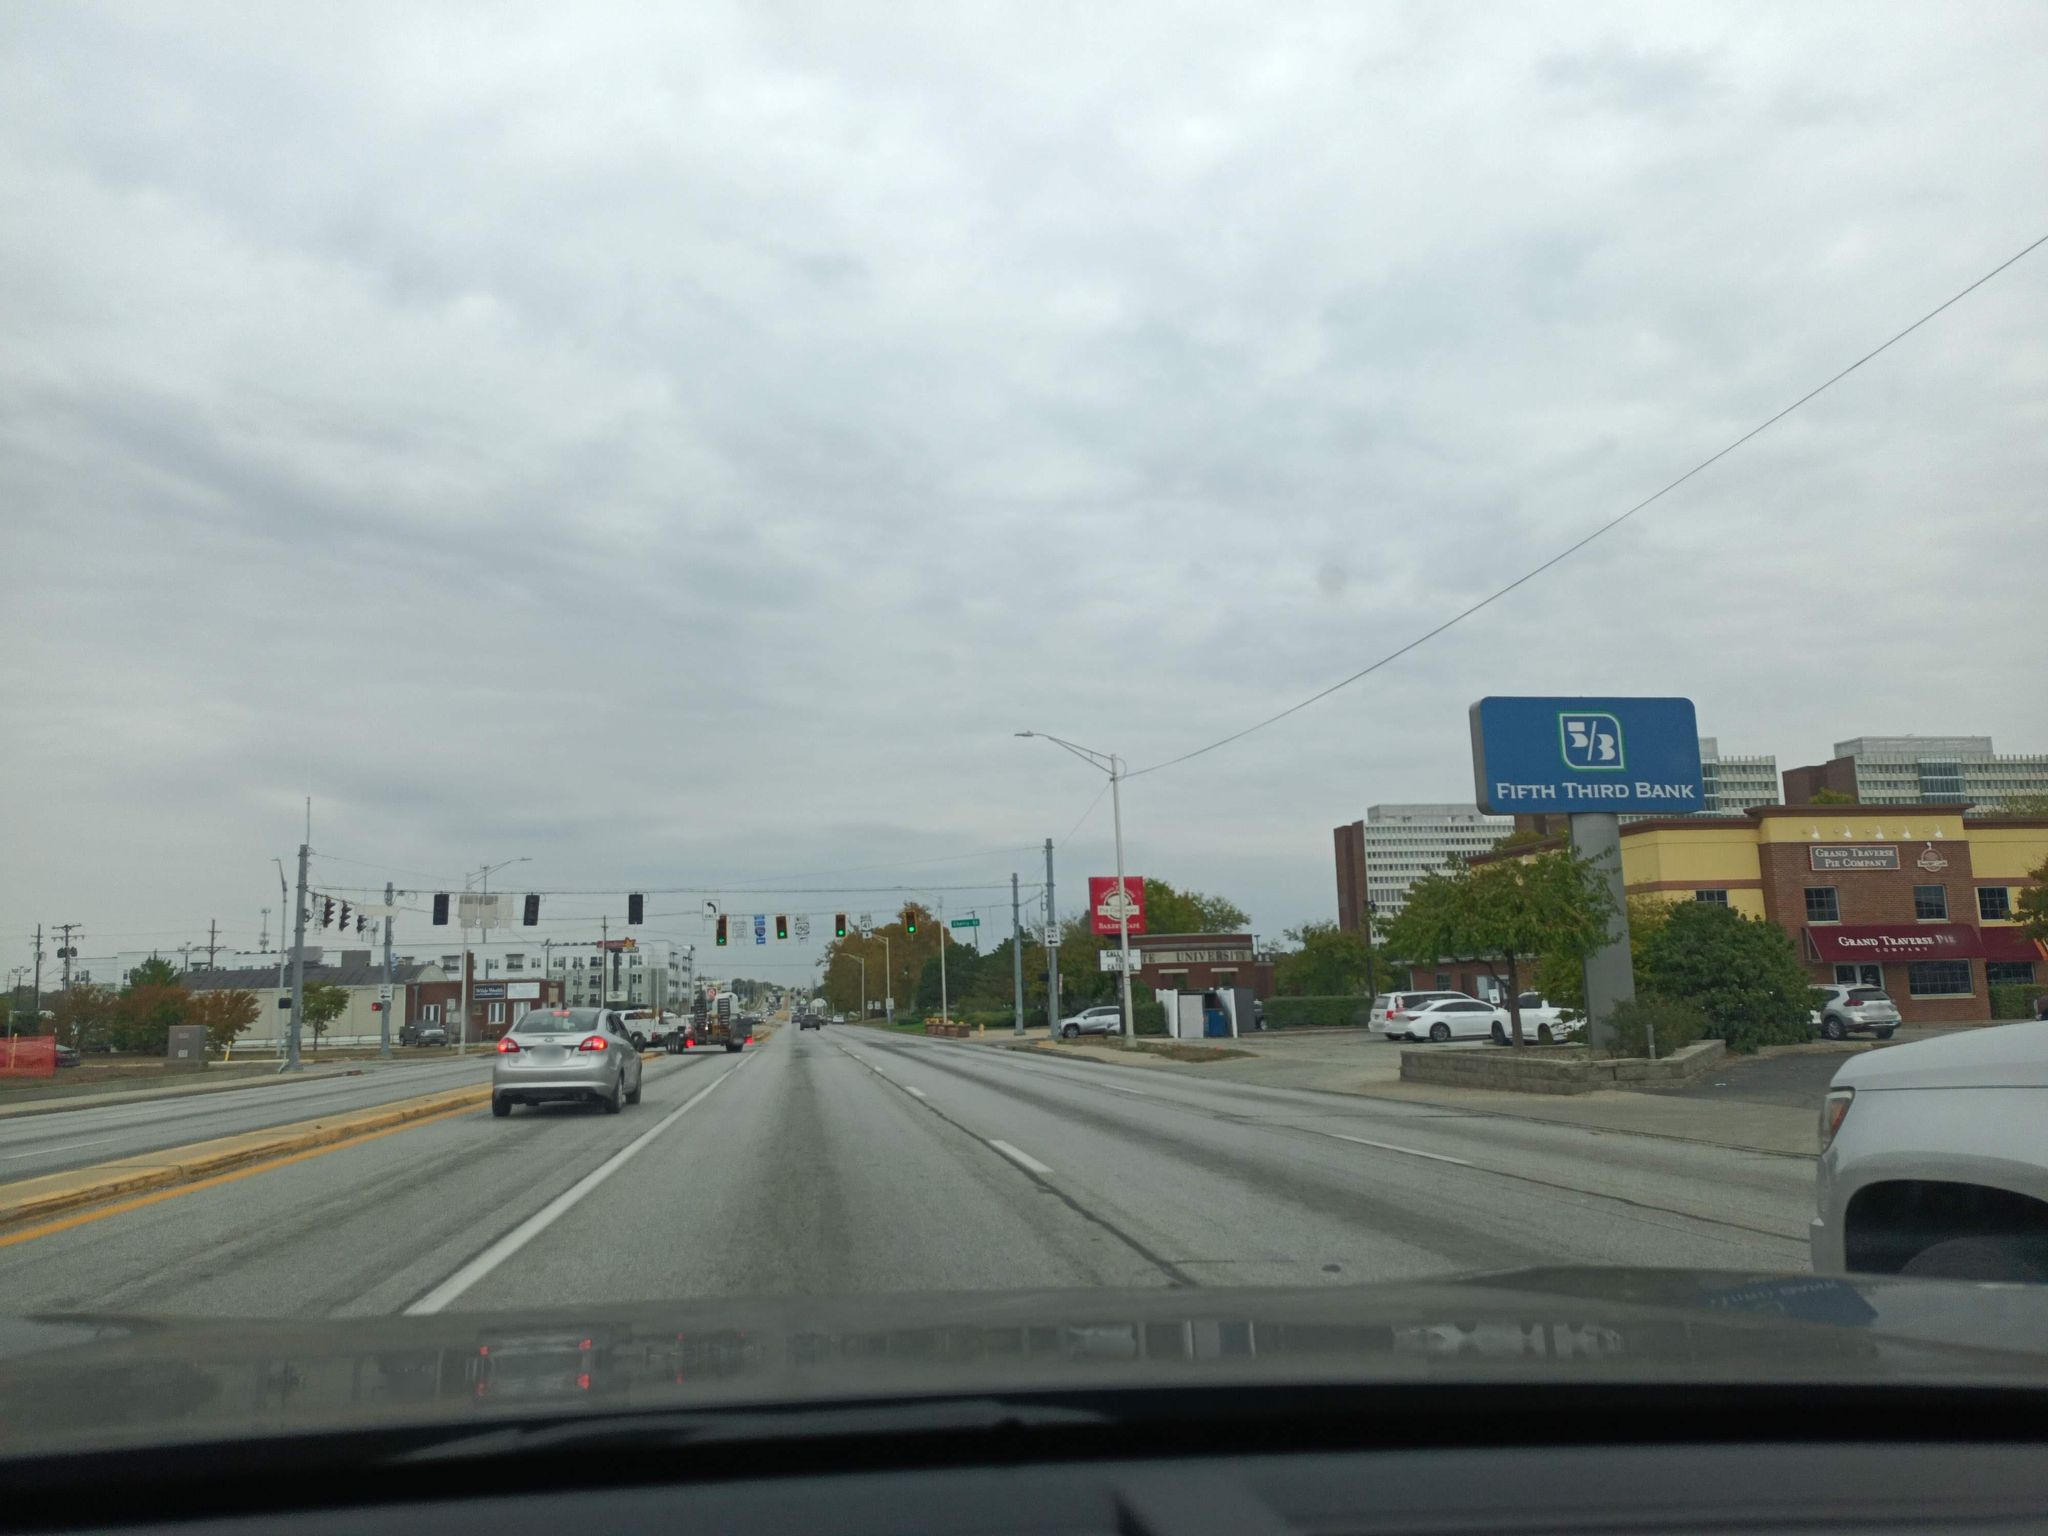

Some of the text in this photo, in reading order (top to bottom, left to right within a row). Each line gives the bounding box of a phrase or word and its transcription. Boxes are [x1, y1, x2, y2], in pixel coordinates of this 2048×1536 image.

[1496, 782, 1694, 799] FIFTH THIRD BANK
[1815, 848, 1894, 858] GRAND TRAVERSE
[1825, 858, 1887, 868] PIE COMPANY
[1838, 934, 1956, 947] GRAND TRAVERSE PIE
[1177, 951, 1247, 962] UNIVERSITY
